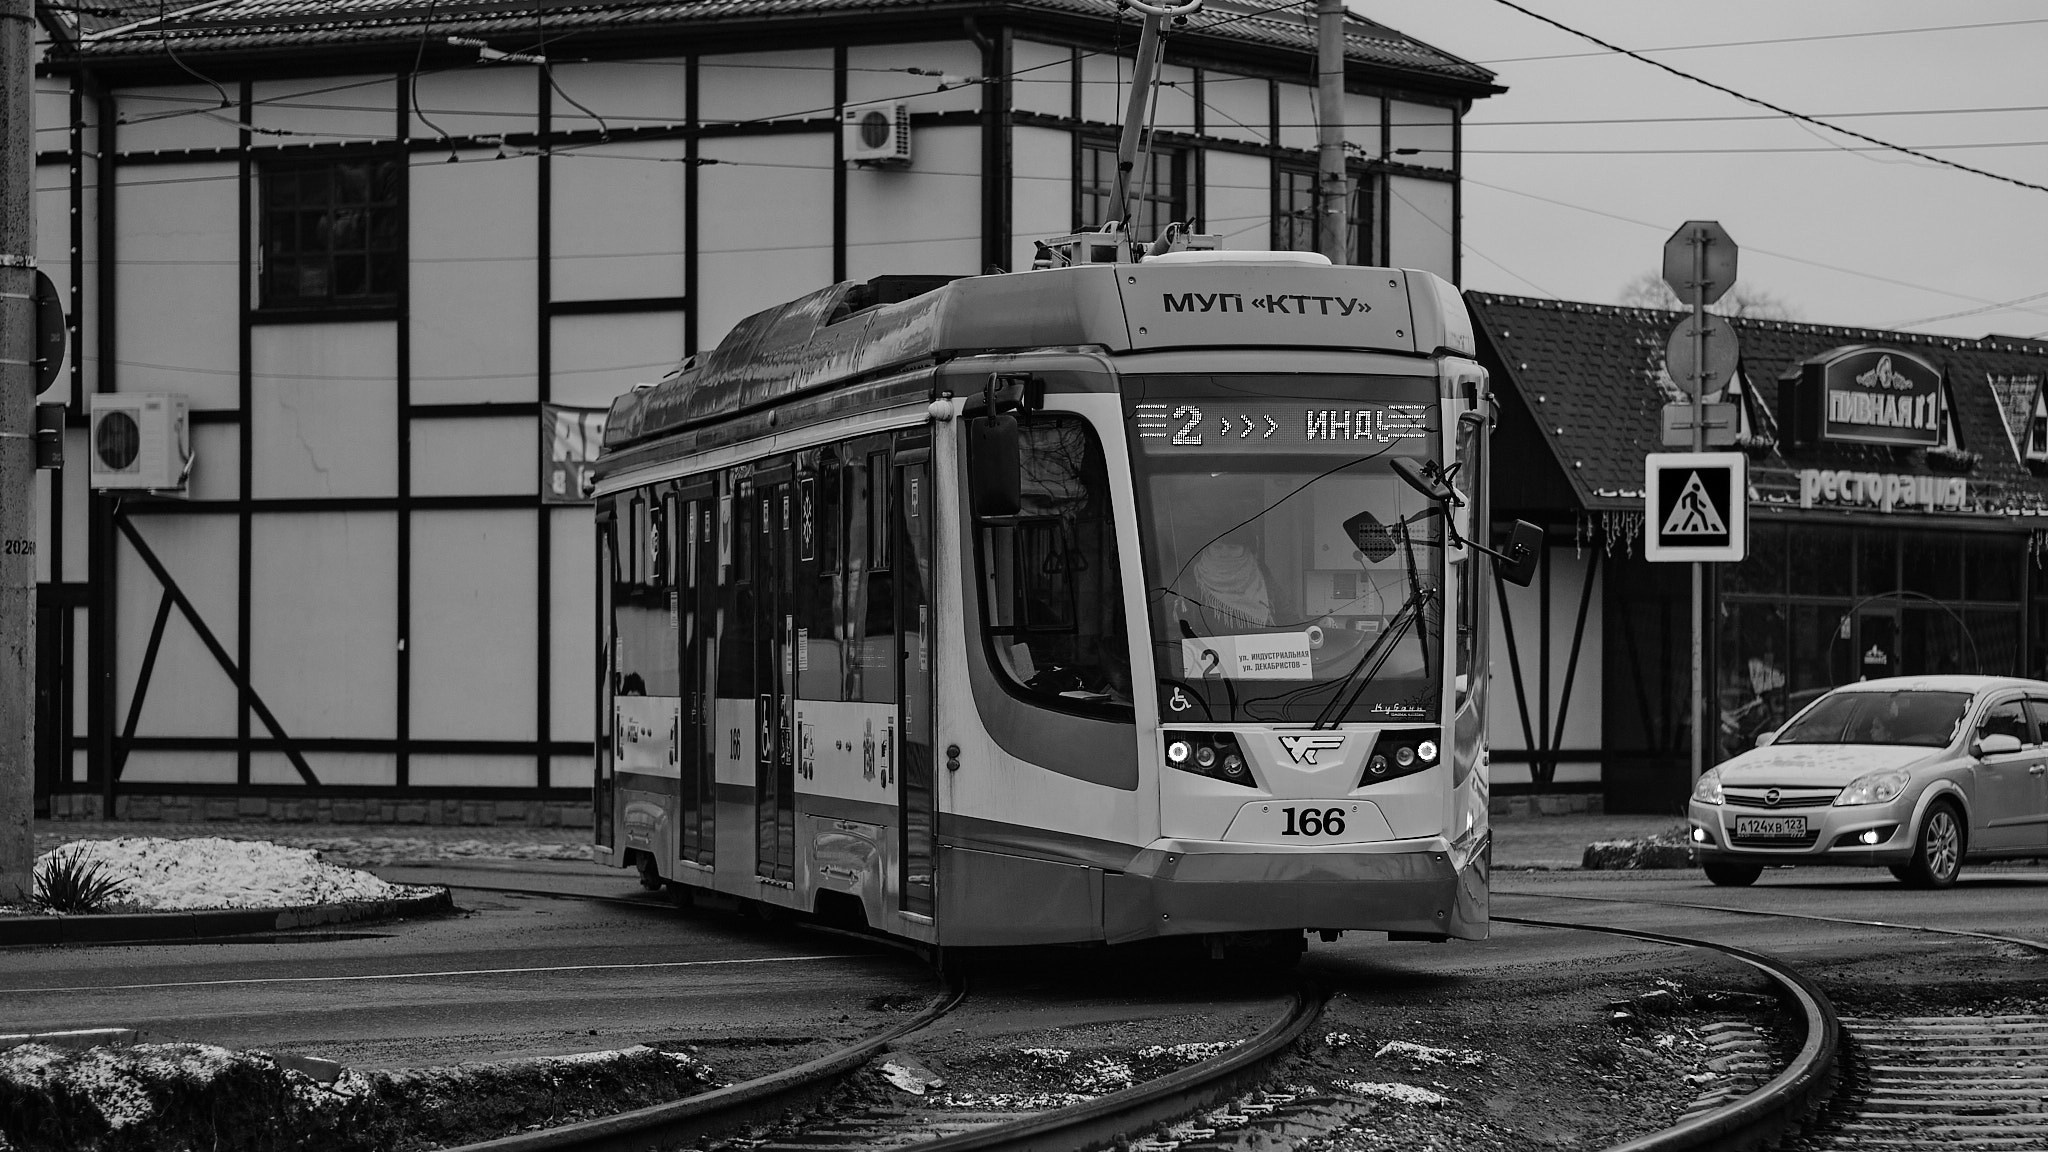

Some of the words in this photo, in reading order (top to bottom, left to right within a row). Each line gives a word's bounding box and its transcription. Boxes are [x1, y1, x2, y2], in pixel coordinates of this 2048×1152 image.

[1163, 292, 1243, 312] МУП
[1252, 295, 1372, 316] «КТТУ»
[1829, 390, 1913, 428] ПИВНАЯ
[1172, 405, 1202, 445] 2
[1800, 469, 1967, 513] ресторация
[1200, 648, 1222, 679] 2
[1238, 654, 1250, 663] ул.
[1252, 651, 1309, 661] ИНДУСТРИАЛЬНАЯ
[1242, 664, 1253, 673] ул.
[1255, 662, 1300, 671] ДЕКАБРИСТОВ
[729, 728, 741, 761] 166
[1281, 807, 1346, 837] 166
[1740, 819, 1783, 833] А124ХВ
[1784, 819, 1803, 830] 123
